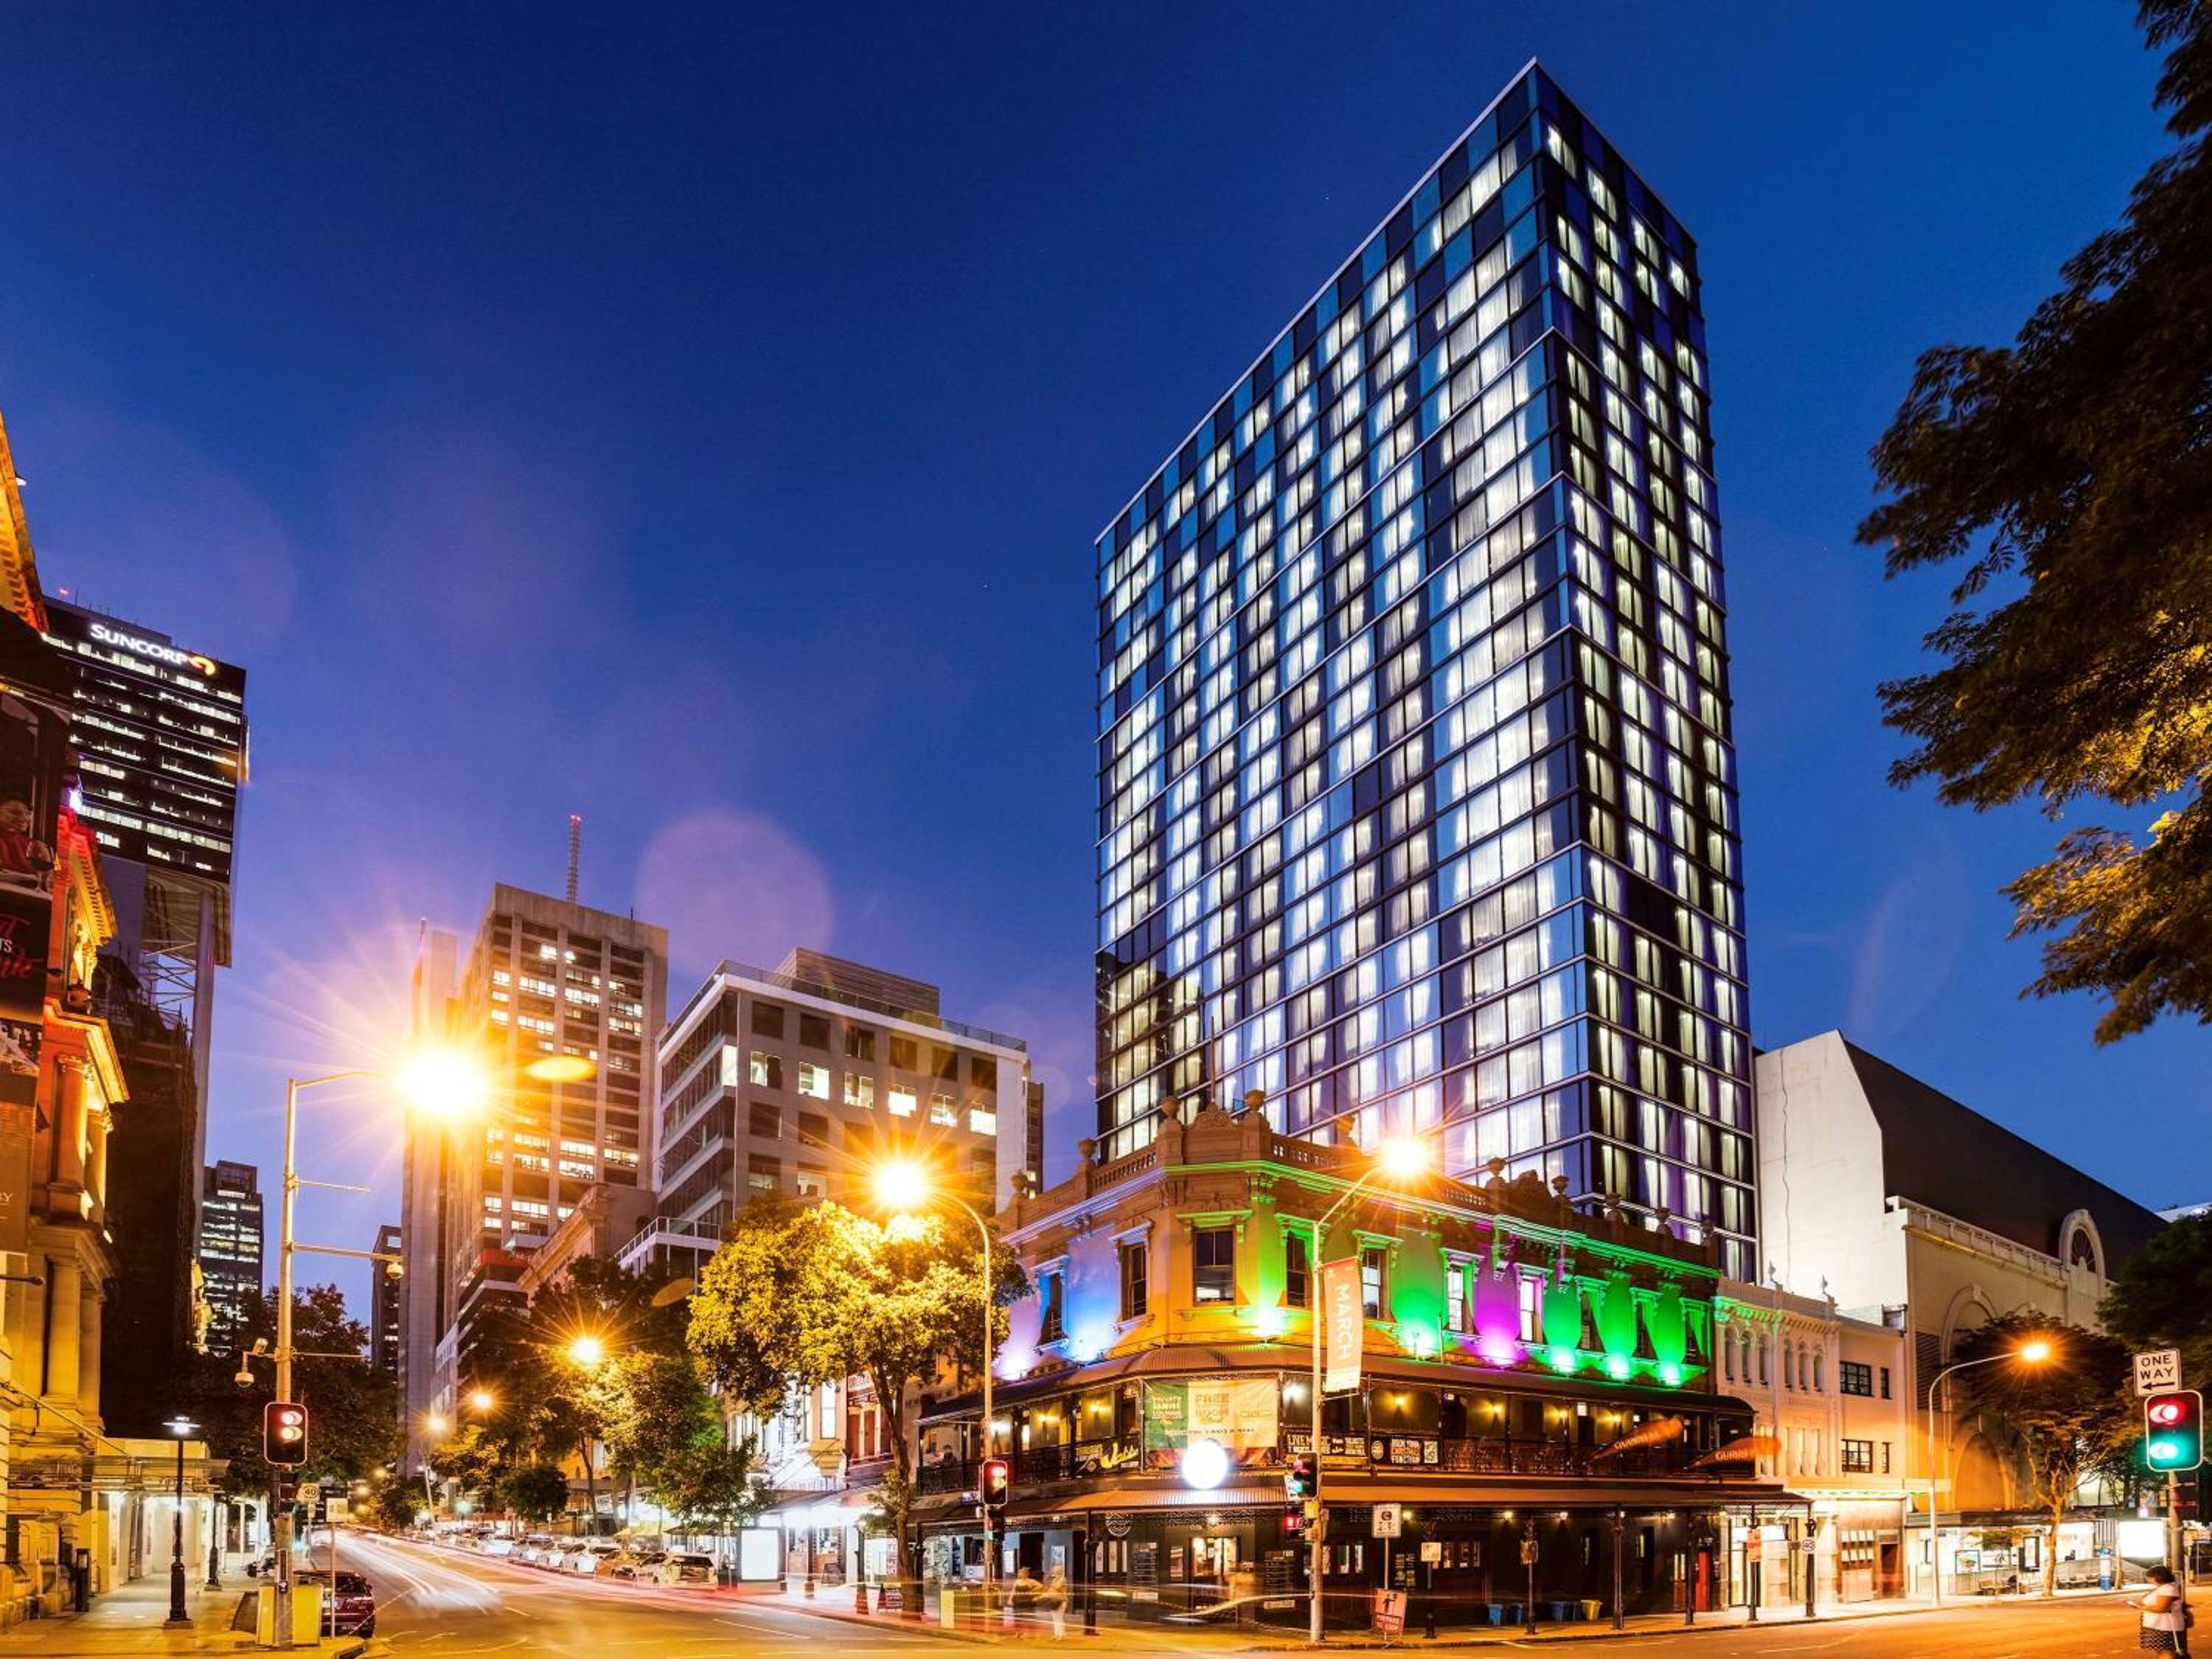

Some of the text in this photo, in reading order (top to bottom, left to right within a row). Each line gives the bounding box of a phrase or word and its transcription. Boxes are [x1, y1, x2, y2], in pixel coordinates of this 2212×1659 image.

[90, 623, 189, 665] SUNCORP
[1335, 1284, 1353, 1359] MARCH
[2140, 1354, 2171, 1367] ONE
[2140, 1366, 2174, 1380] WAY
